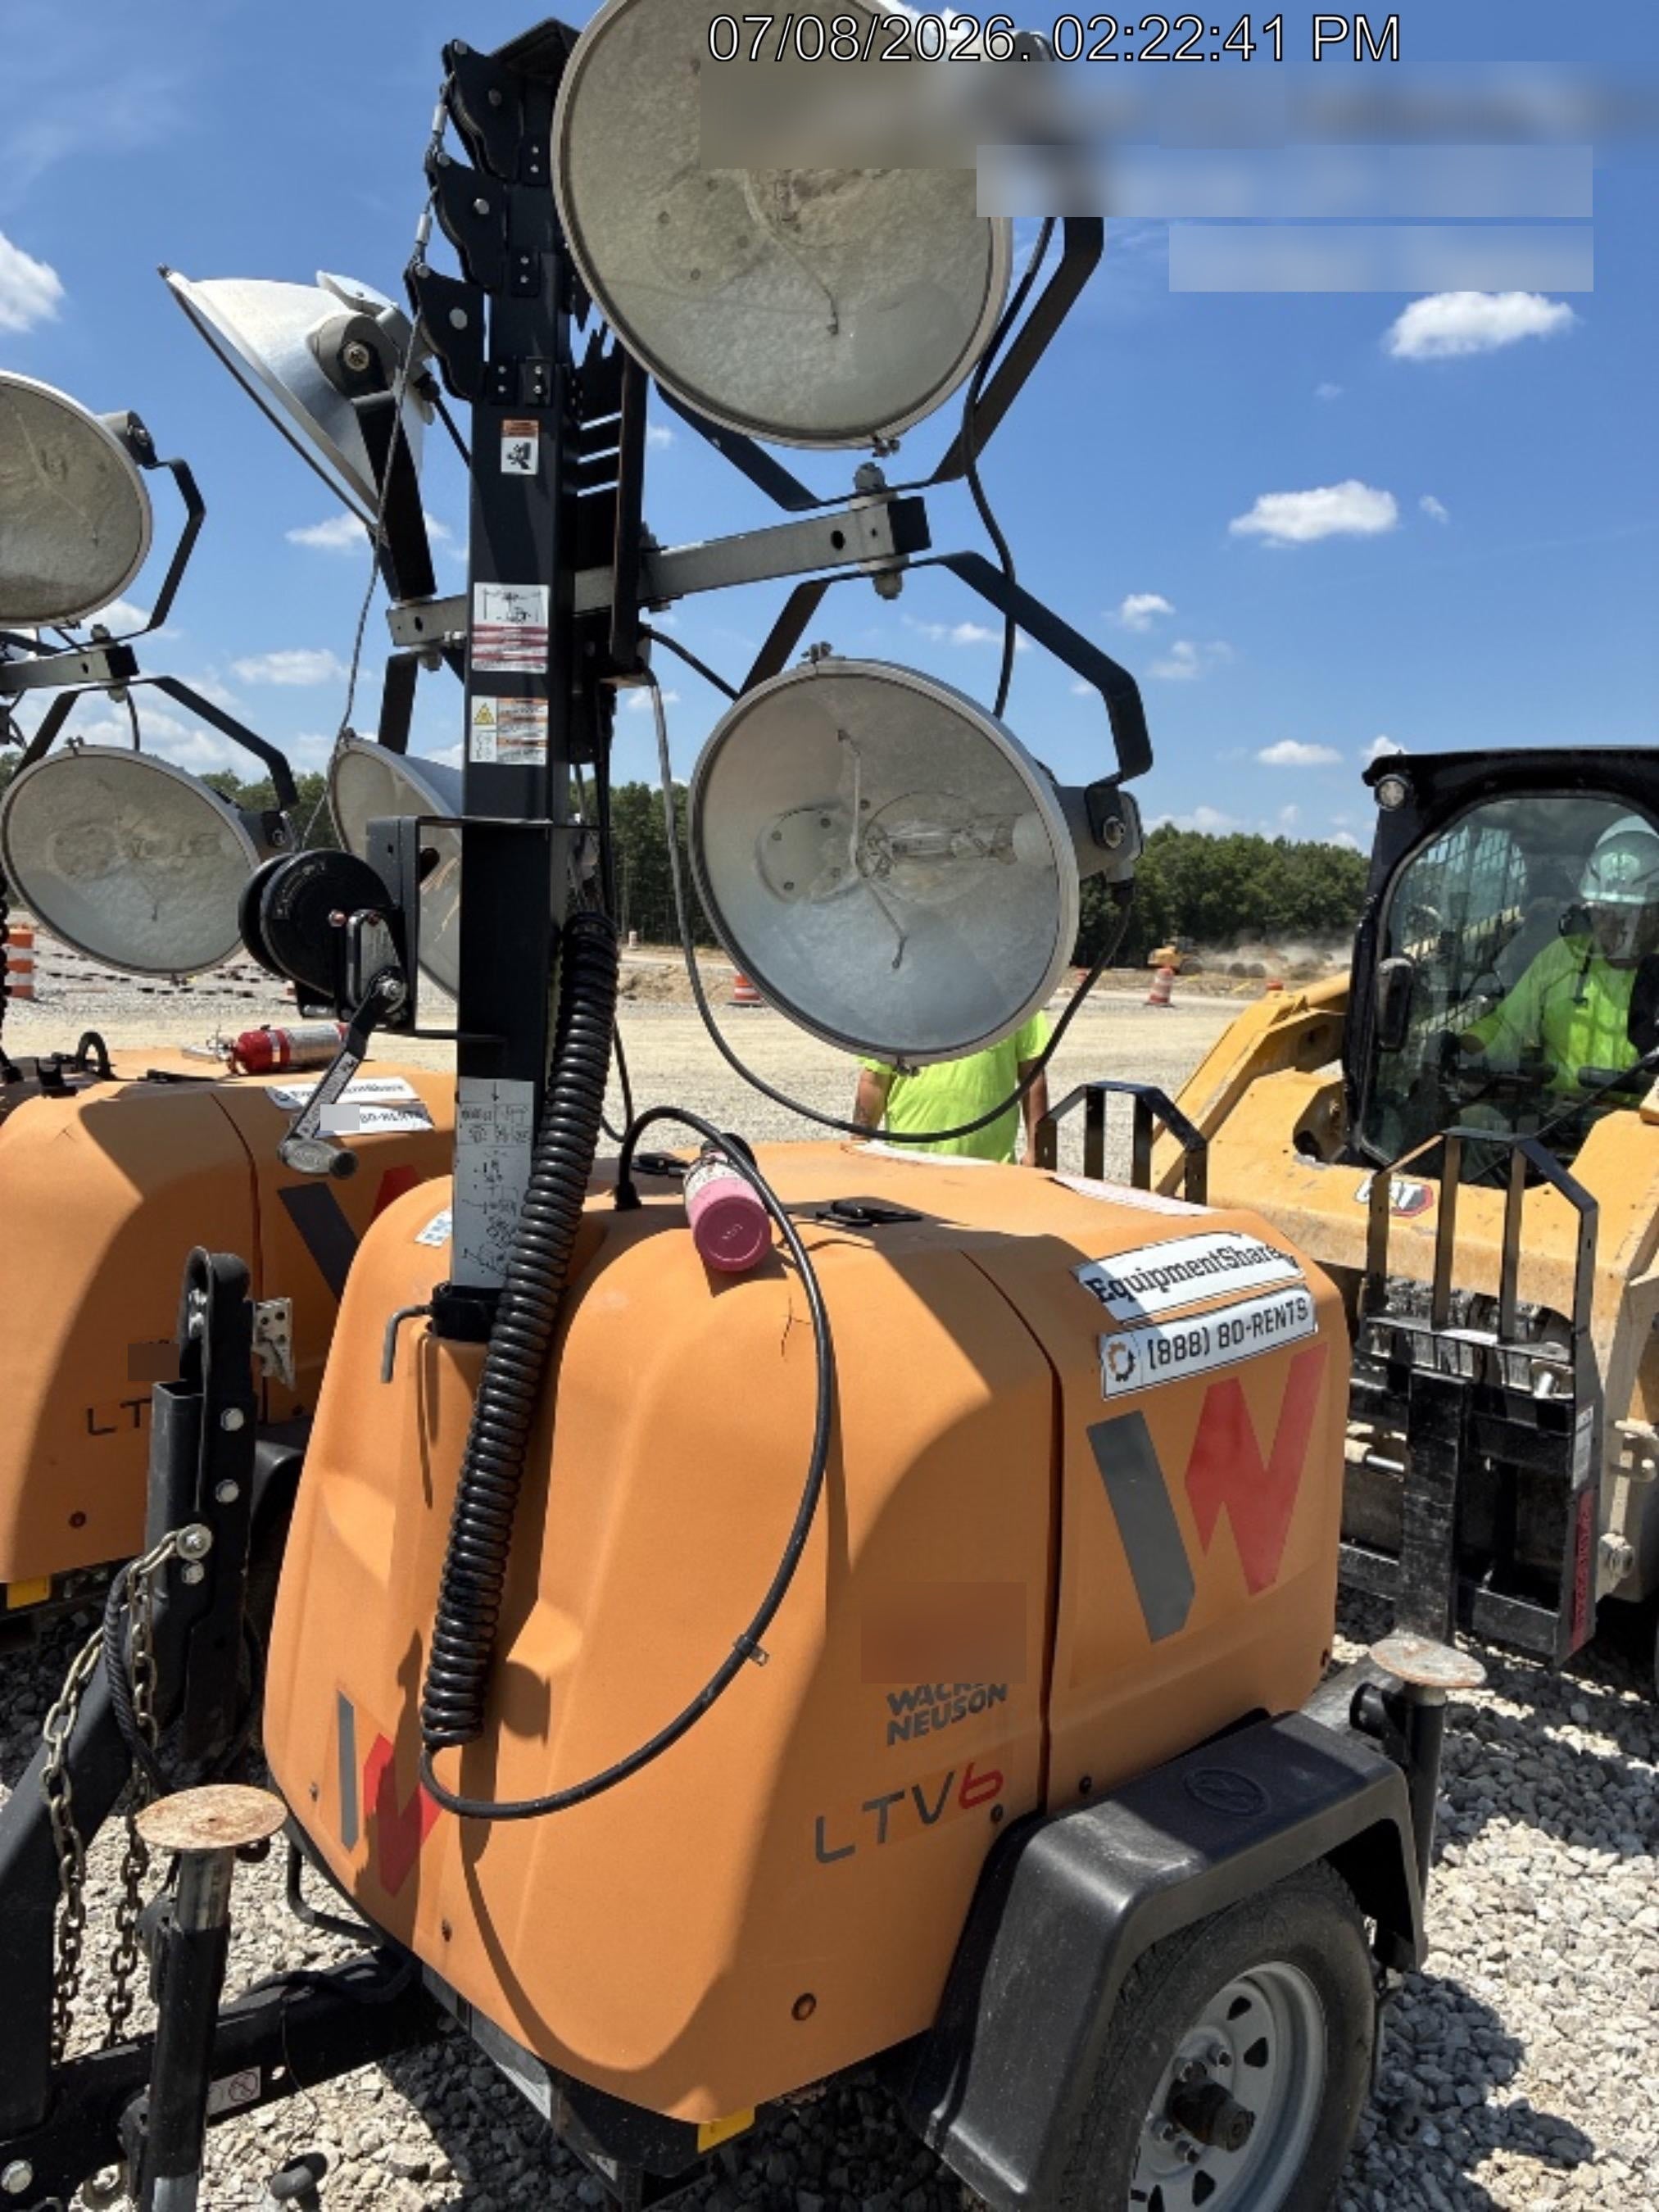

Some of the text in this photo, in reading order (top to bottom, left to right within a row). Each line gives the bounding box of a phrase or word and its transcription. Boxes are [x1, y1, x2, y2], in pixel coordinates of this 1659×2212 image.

[1084, 1244, 1283, 1303] EquipmentShare
[1148, 1297, 1310, 1370] (888) 80-RENTS
[87, 1398, 152, 1435] LT
[886, 1684, 1009, 1746] NEUSON
[814, 1761, 1004, 1865] LTV6
